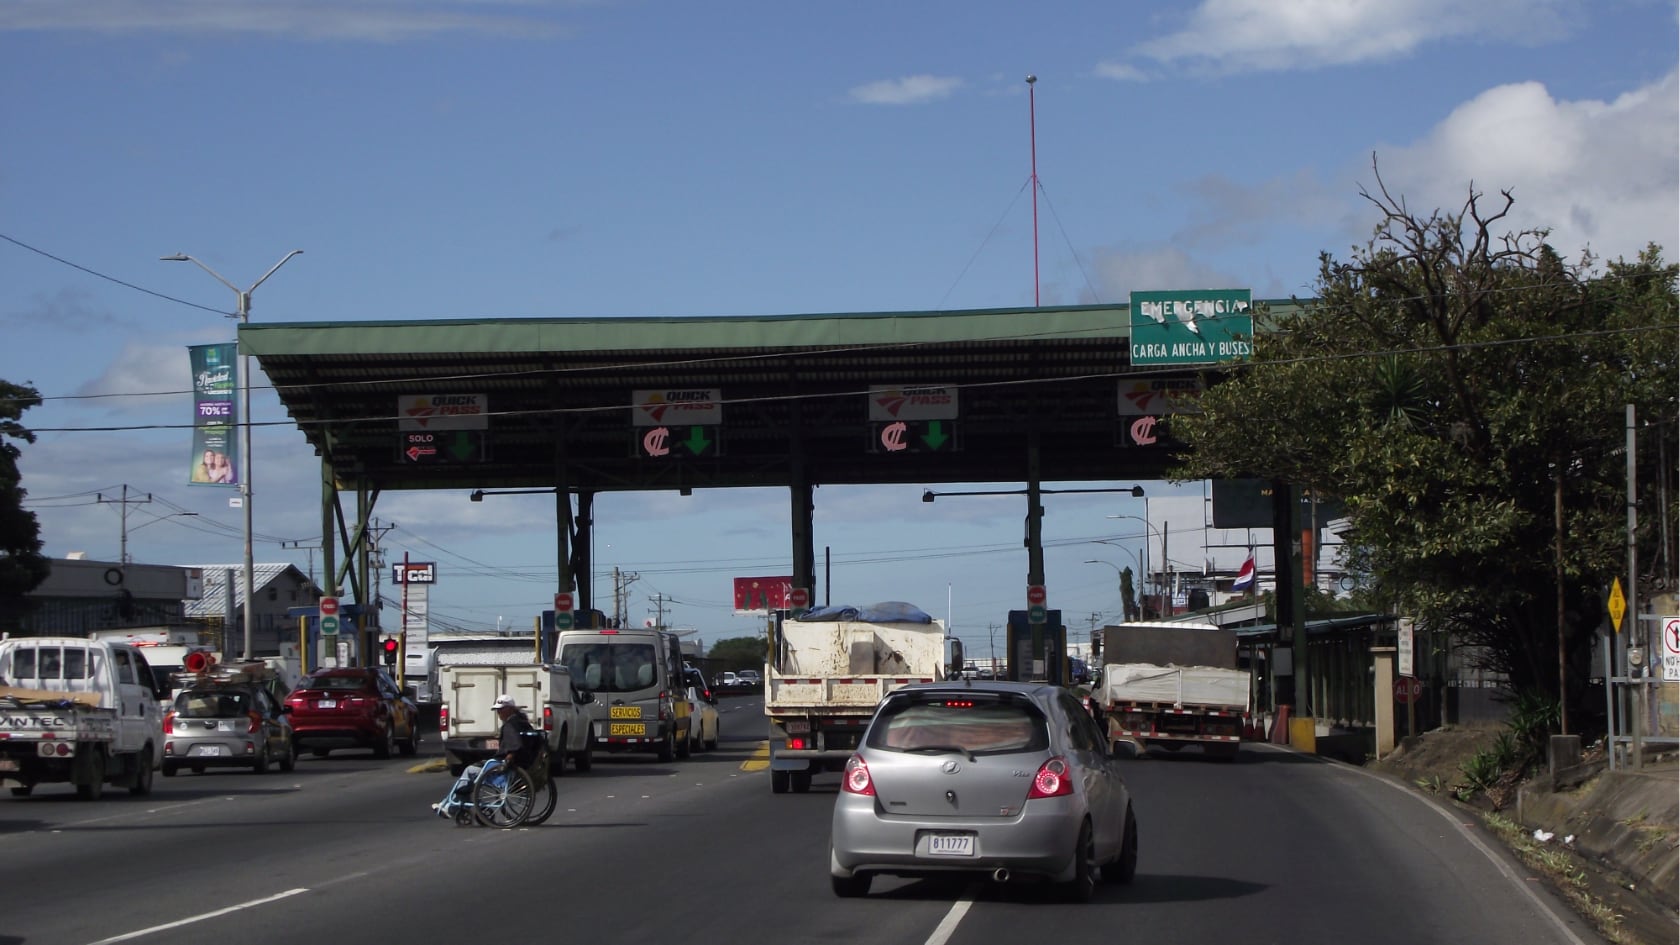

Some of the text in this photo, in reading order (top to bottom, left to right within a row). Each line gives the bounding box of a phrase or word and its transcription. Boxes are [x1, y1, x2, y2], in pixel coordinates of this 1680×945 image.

[1132, 341, 1250, 358] CARGA ANCHA Y BUSES
[432, 395, 477, 407] QUICK
[666, 391, 712, 402] QUICK
[911, 395, 952, 405] PASS
[199, 406, 221, 415] 70%
[440, 405, 481, 415] PASS
[408, 434, 434, 443] SOLO
[1396, 684, 1420, 695] ALO
[611, 707, 641, 718] SERVICIOS
[611, 724, 644, 735] ESPECIALES
[933, 837, 969, 849] 811777
